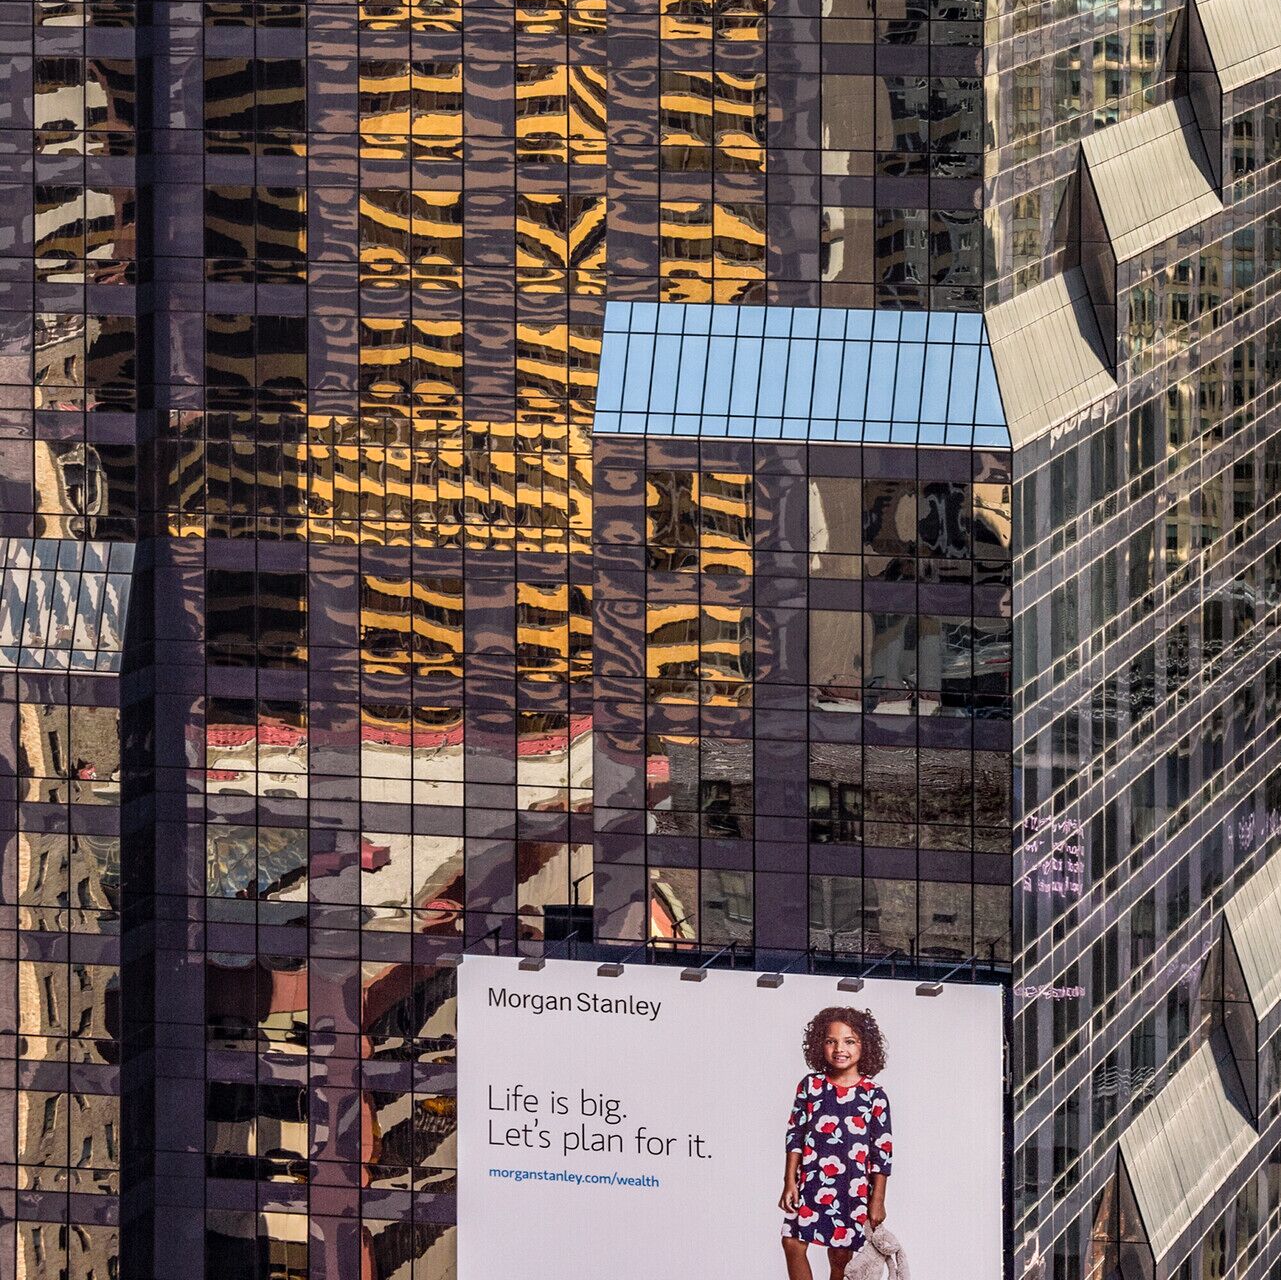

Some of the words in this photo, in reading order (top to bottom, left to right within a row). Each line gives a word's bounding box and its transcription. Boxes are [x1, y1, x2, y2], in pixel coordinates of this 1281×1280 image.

[487, 986, 573, 1016] Morgan
[576, 990, 662, 1022] Stanley
[487, 1083, 539, 1114] Life
[550, 1089, 569, 1116] is
[580, 1089, 628, 1124] big.
[487, 1119, 551, 1150] Let's
[563, 1122, 624, 1158] plan
[634, 1126, 678, 1157] for
[686, 1131, 714, 1160] it.
[488, 1166, 660, 1190] morganstanley.com/wealth
